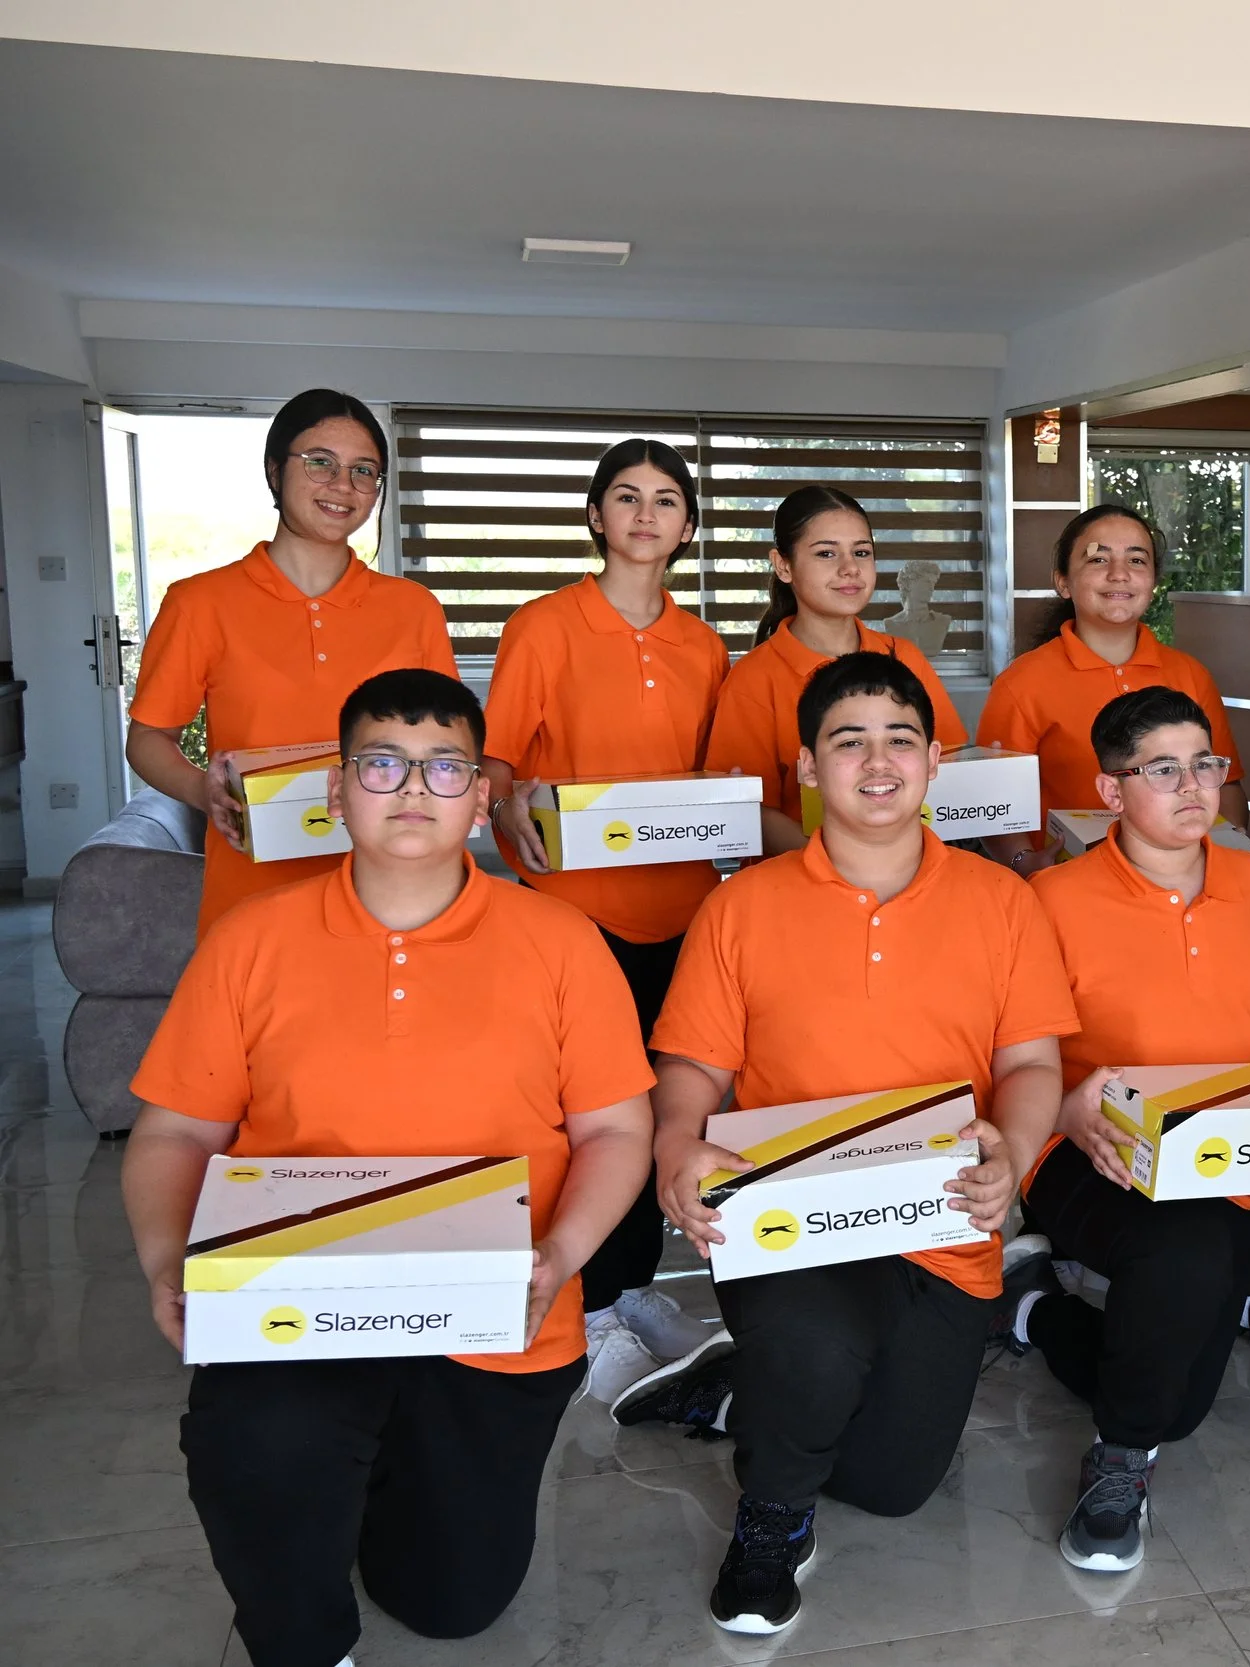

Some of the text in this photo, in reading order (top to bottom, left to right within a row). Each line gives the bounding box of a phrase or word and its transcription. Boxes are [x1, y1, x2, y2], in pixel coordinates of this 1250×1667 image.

[936, 803, 1011, 821] Slazenger
[637, 821, 727, 842] Slazenger
[829, 1140, 923, 1161] Slazenger
[271, 1168, 391, 1180] Slazenger
[806, 1197, 945, 1235] Slazenger
[315, 1311, 452, 1334] Slazenger
